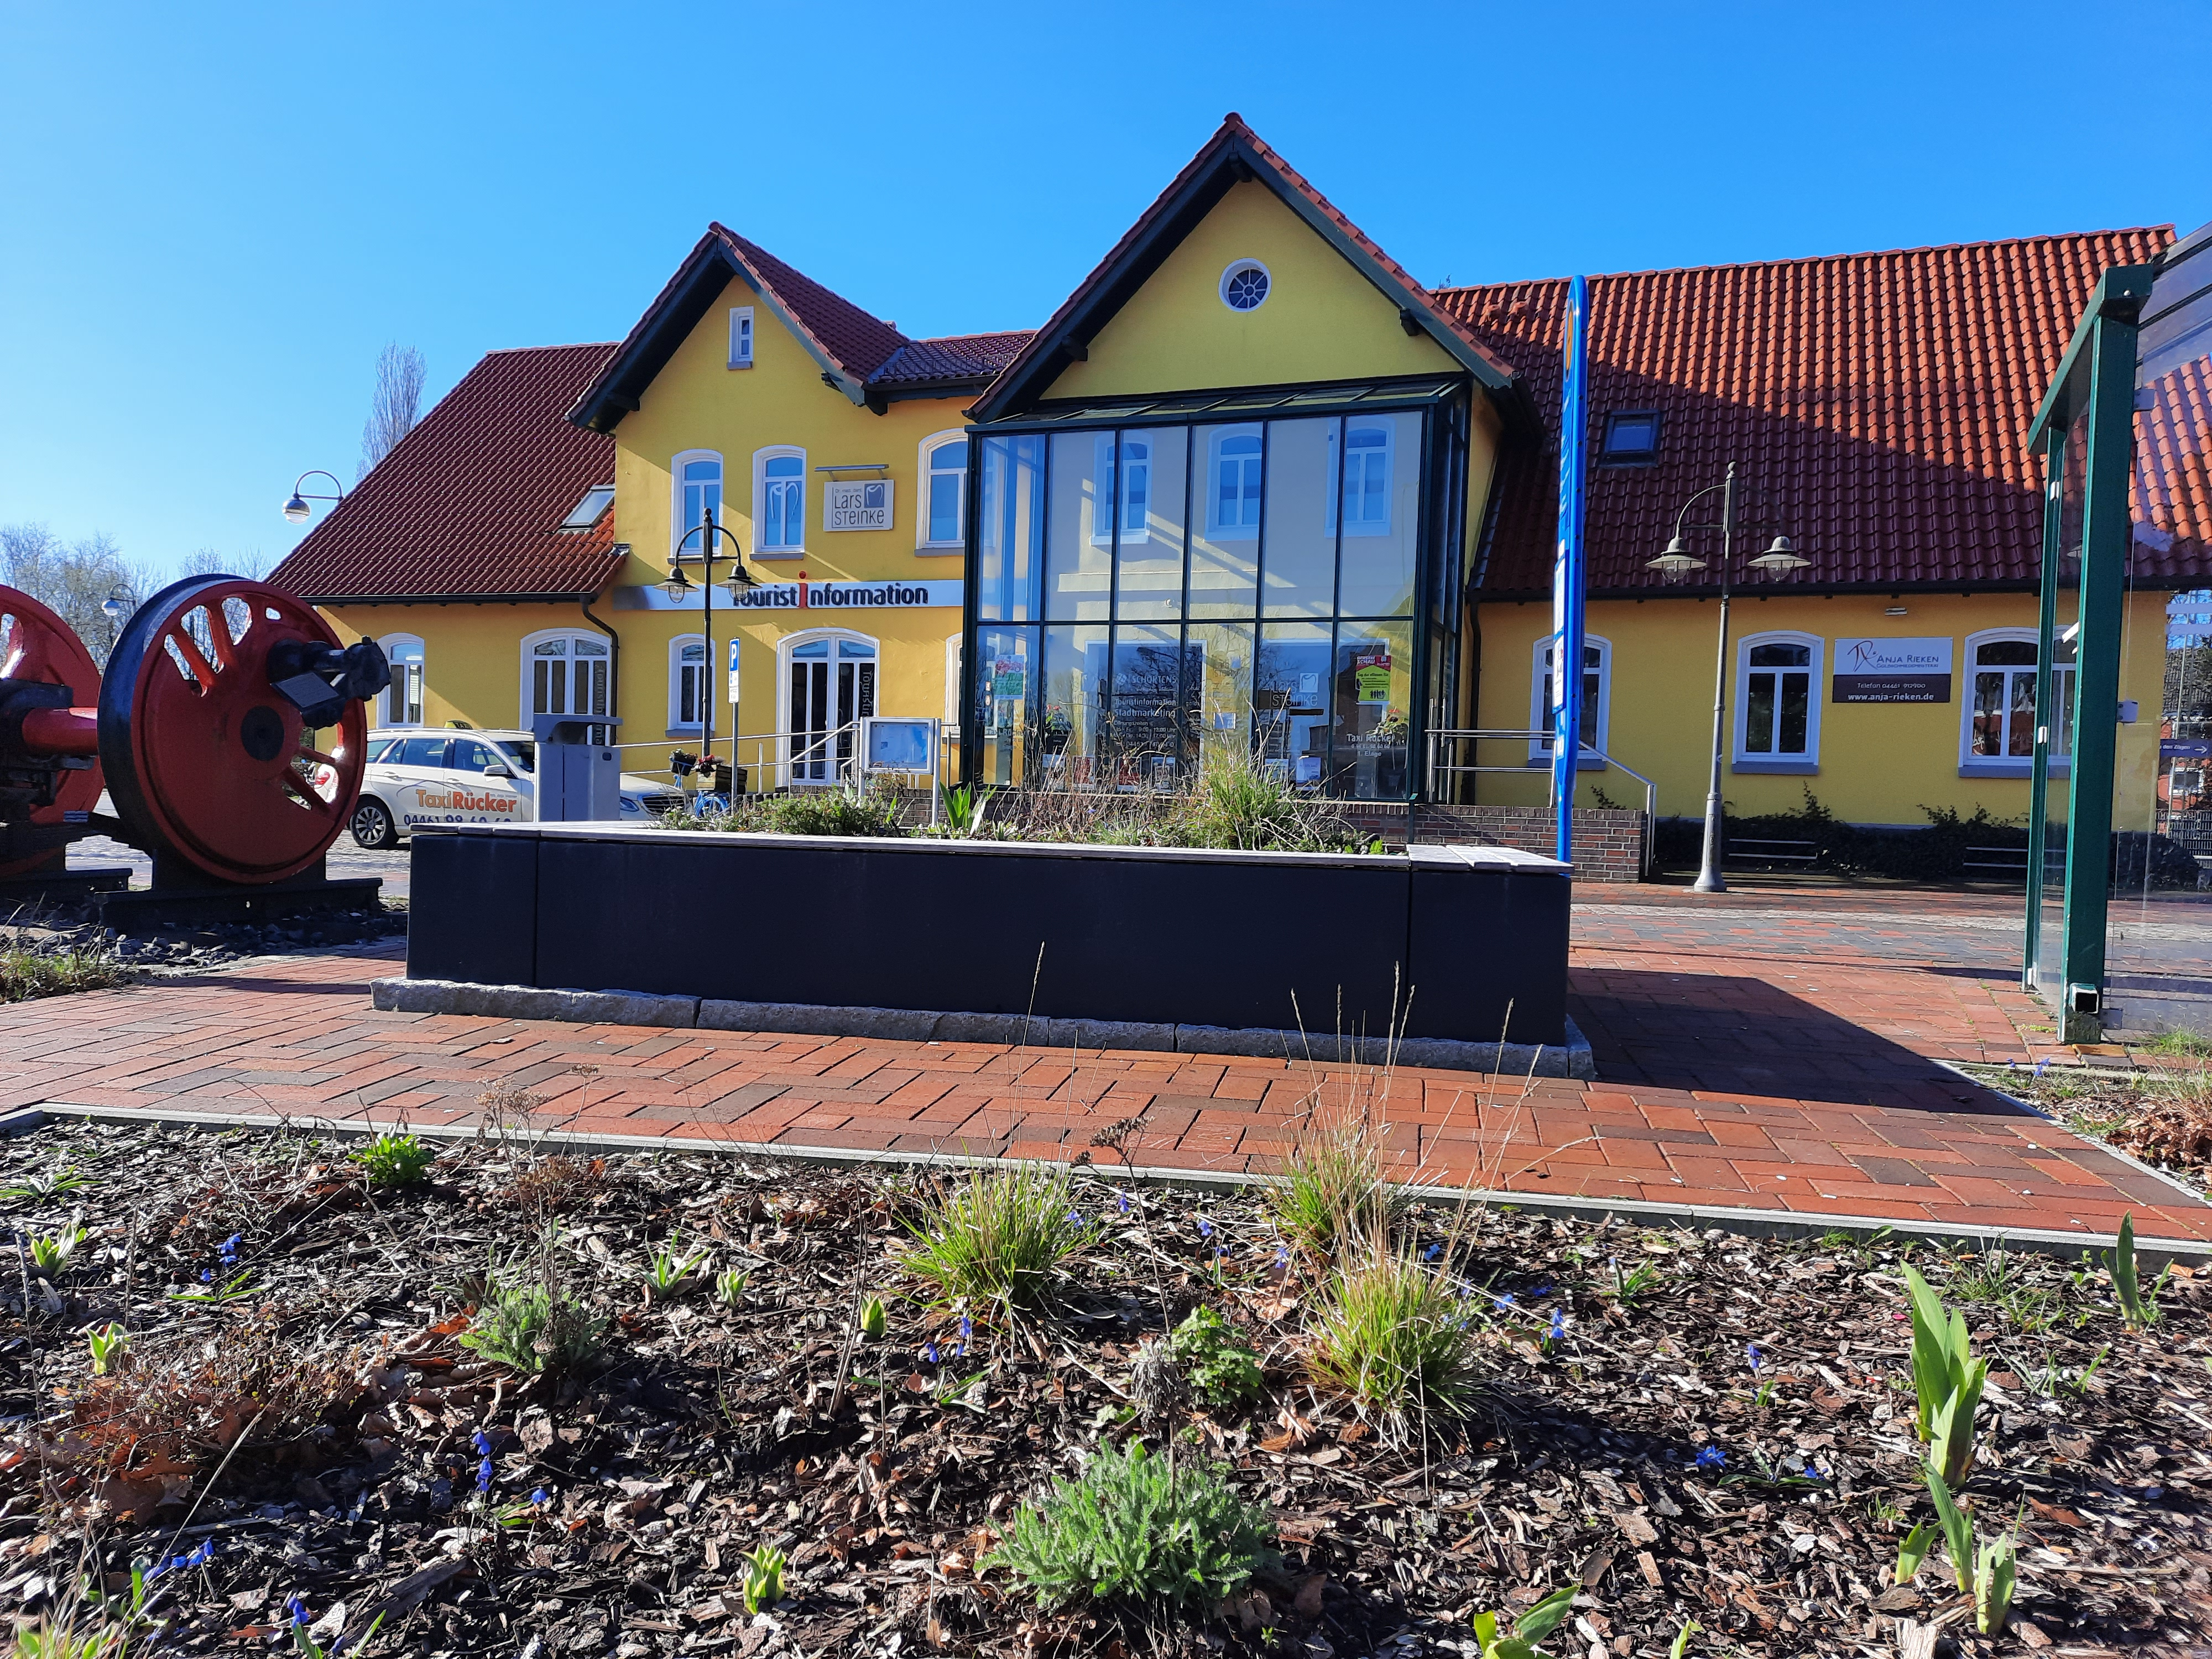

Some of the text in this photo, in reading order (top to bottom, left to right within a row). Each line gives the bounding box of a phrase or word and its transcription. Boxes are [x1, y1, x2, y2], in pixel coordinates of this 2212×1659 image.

[834, 494, 862, 509] Lars
[731, 643, 737, 669] P
[1132, 675, 1176, 684] SCHORTENS
[1848, 692, 1934, 702] www.anja-rieken.de
